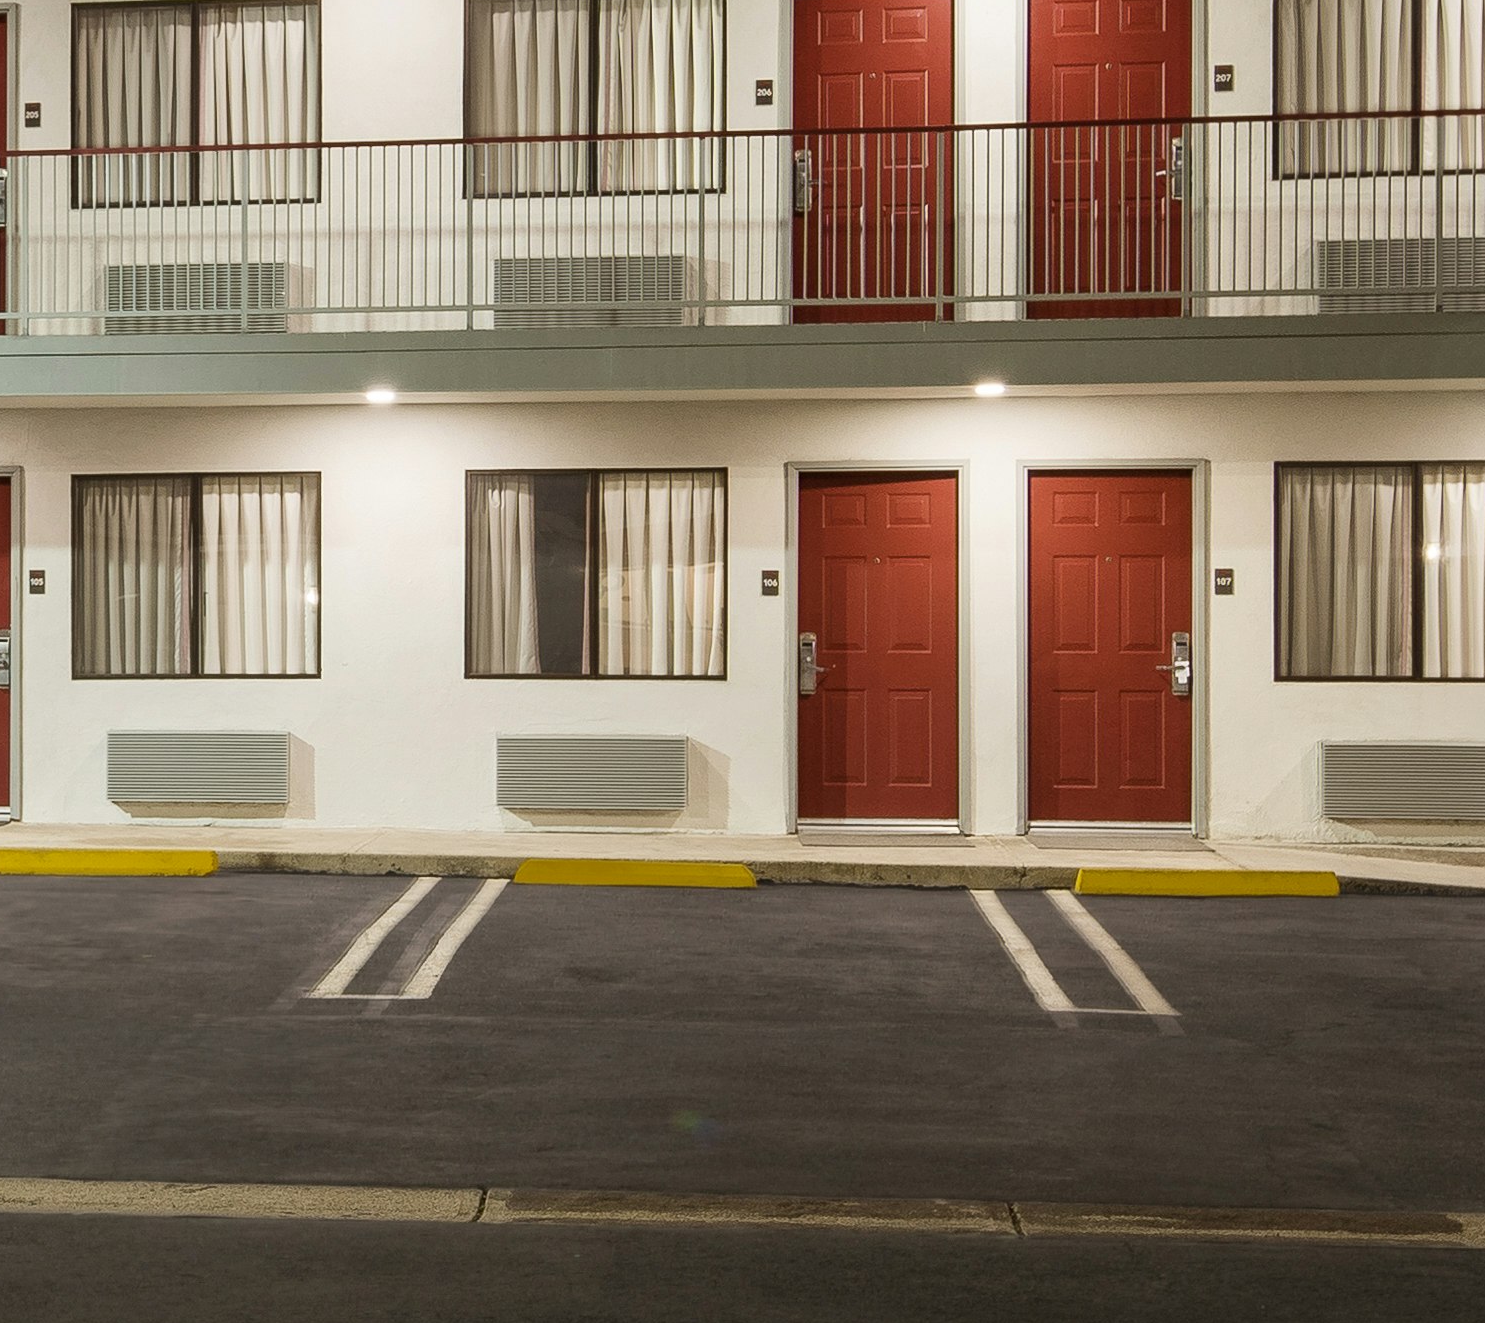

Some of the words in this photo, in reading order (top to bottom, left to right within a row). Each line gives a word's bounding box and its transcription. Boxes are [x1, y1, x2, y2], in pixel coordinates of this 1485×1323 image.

[1215, 73, 1232, 82] 207
[756, 88, 772, 97] 206
[25, 110, 39, 119] 205
[30, 577, 44, 586] 105
[763, 579, 778, 587] 106
[1216, 578, 1232, 586] 107
